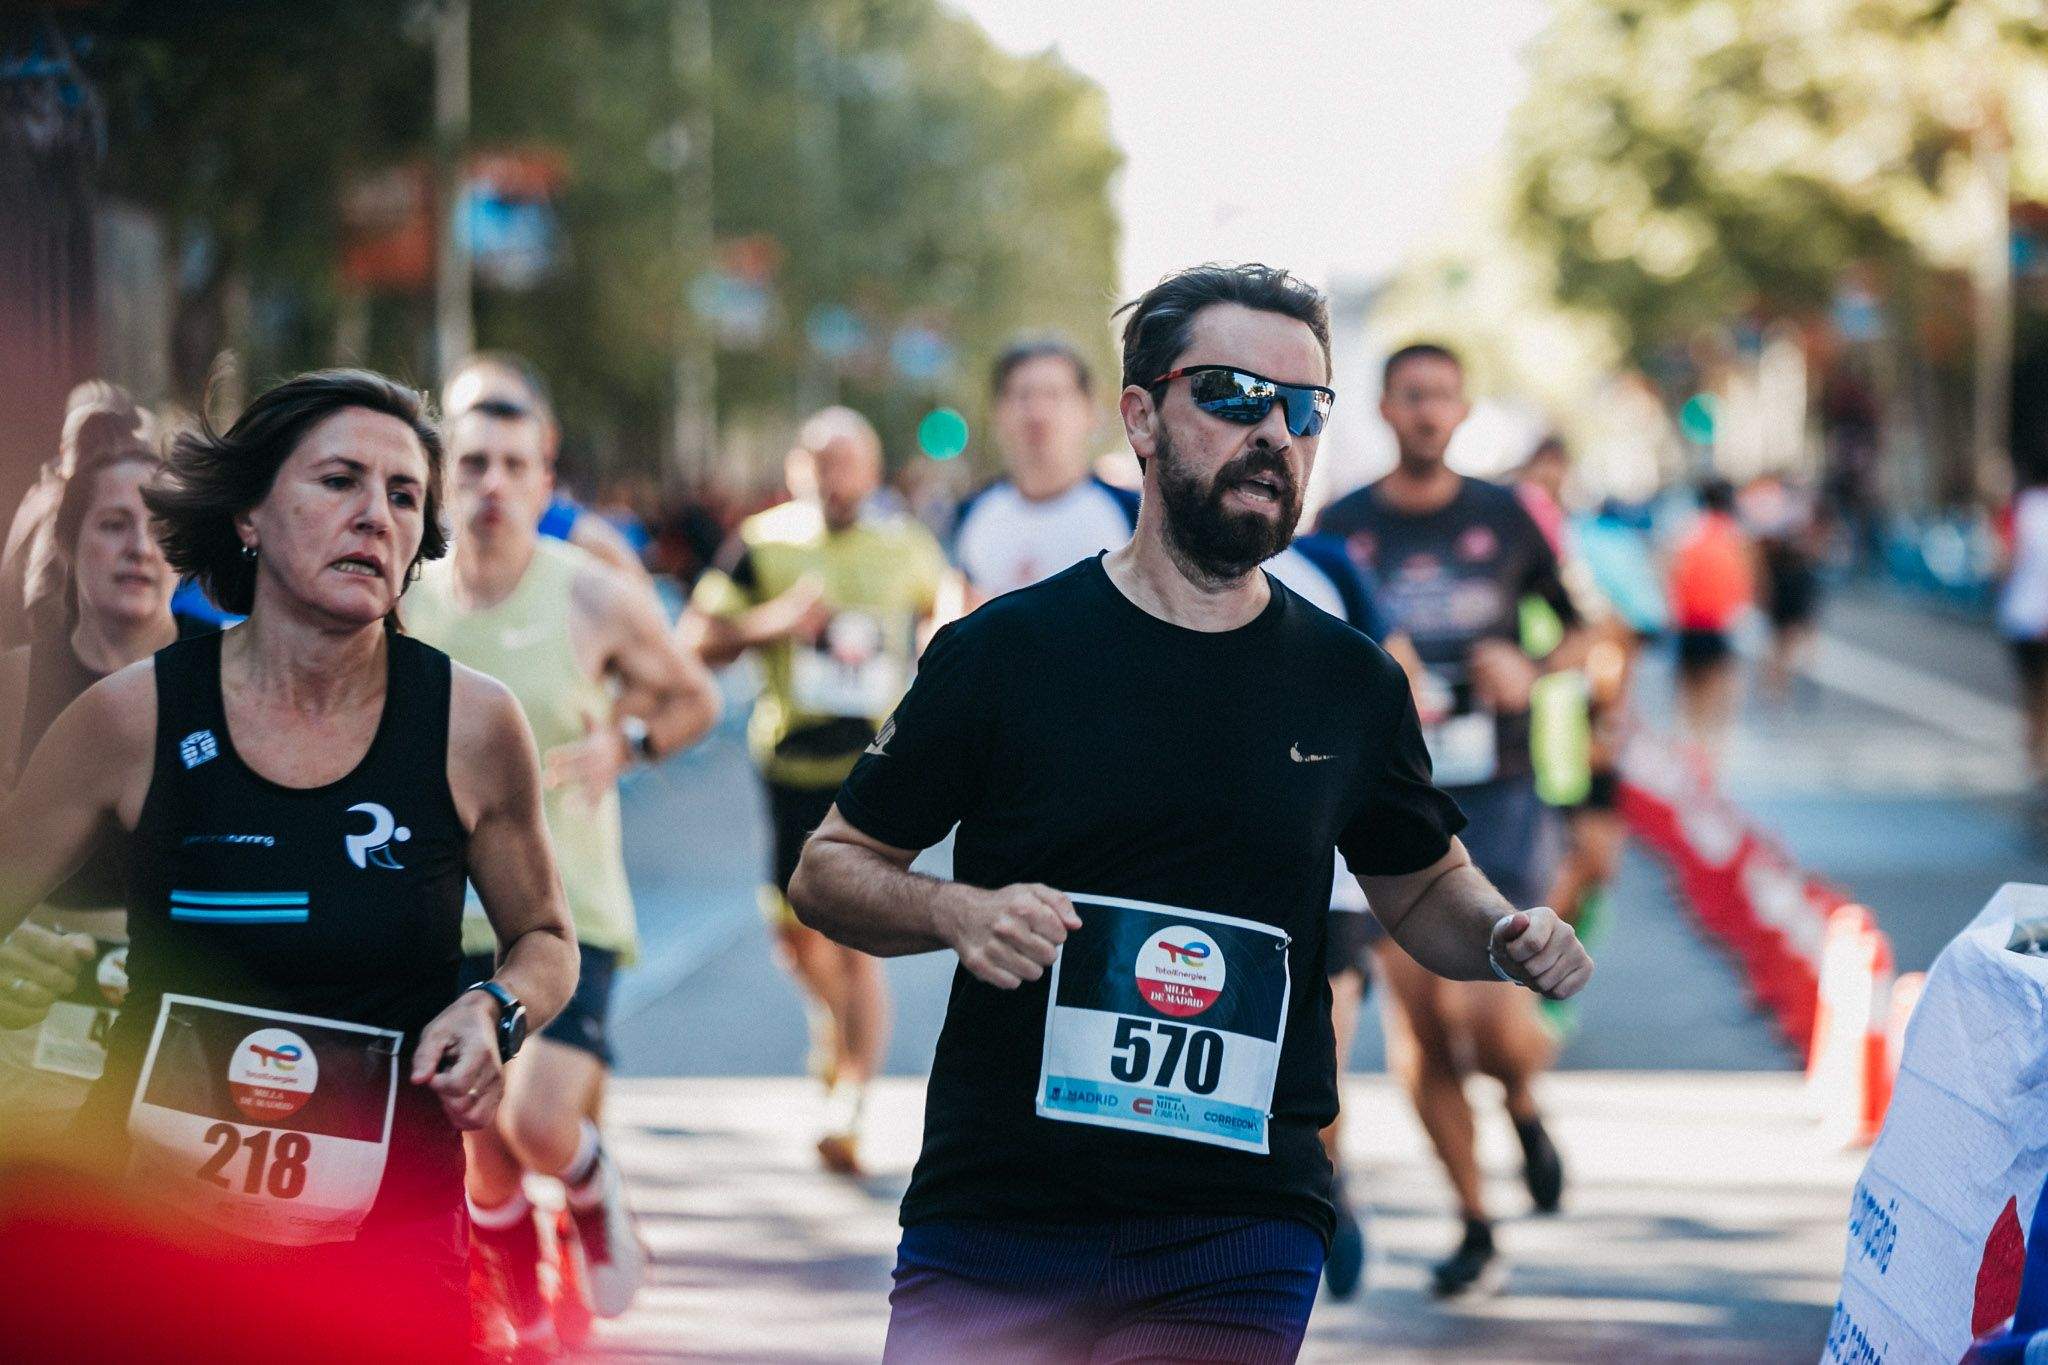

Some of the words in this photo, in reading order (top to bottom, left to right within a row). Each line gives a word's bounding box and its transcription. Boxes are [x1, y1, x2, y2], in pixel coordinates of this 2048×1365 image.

[1155, 965, 1207, 982] TotalEnergies
[1164, 983, 1194, 997] MILLA
[1150, 991, 1164, 1002] DE
[1165, 994, 1204, 1009] MADRID
[1110, 1017, 1224, 1095] 570
[1067, 1089, 1119, 1107] MADRID
[197, 1122, 311, 1199] 218
